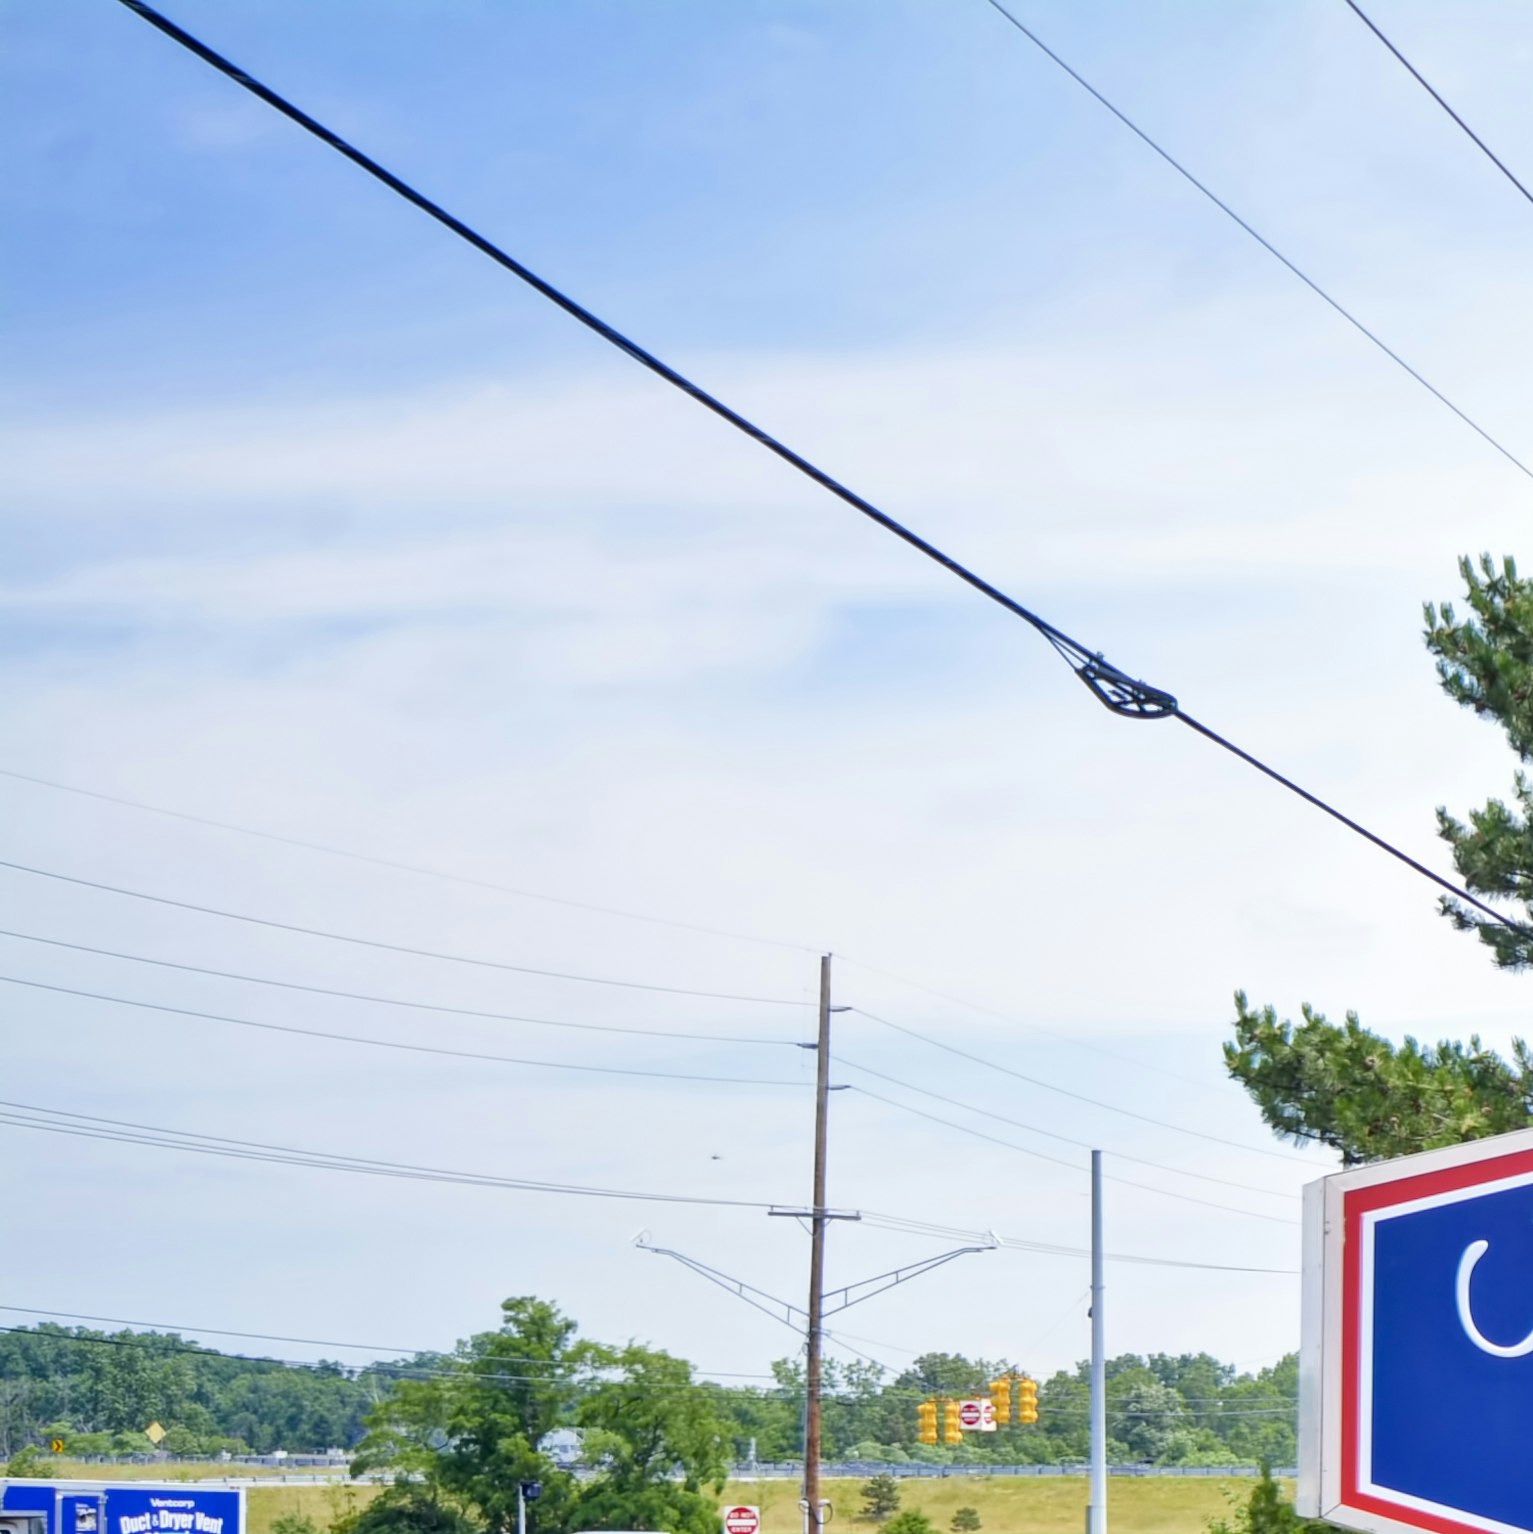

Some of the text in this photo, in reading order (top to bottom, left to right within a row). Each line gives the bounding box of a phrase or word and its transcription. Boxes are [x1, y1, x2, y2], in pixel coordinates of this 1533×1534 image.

[149, 1498, 195, 1509] Ventcorp
[120, 1512, 152, 1534] Duct
[159, 1510, 194, 1530] Dryer
[195, 1512, 223, 1534] Vent
